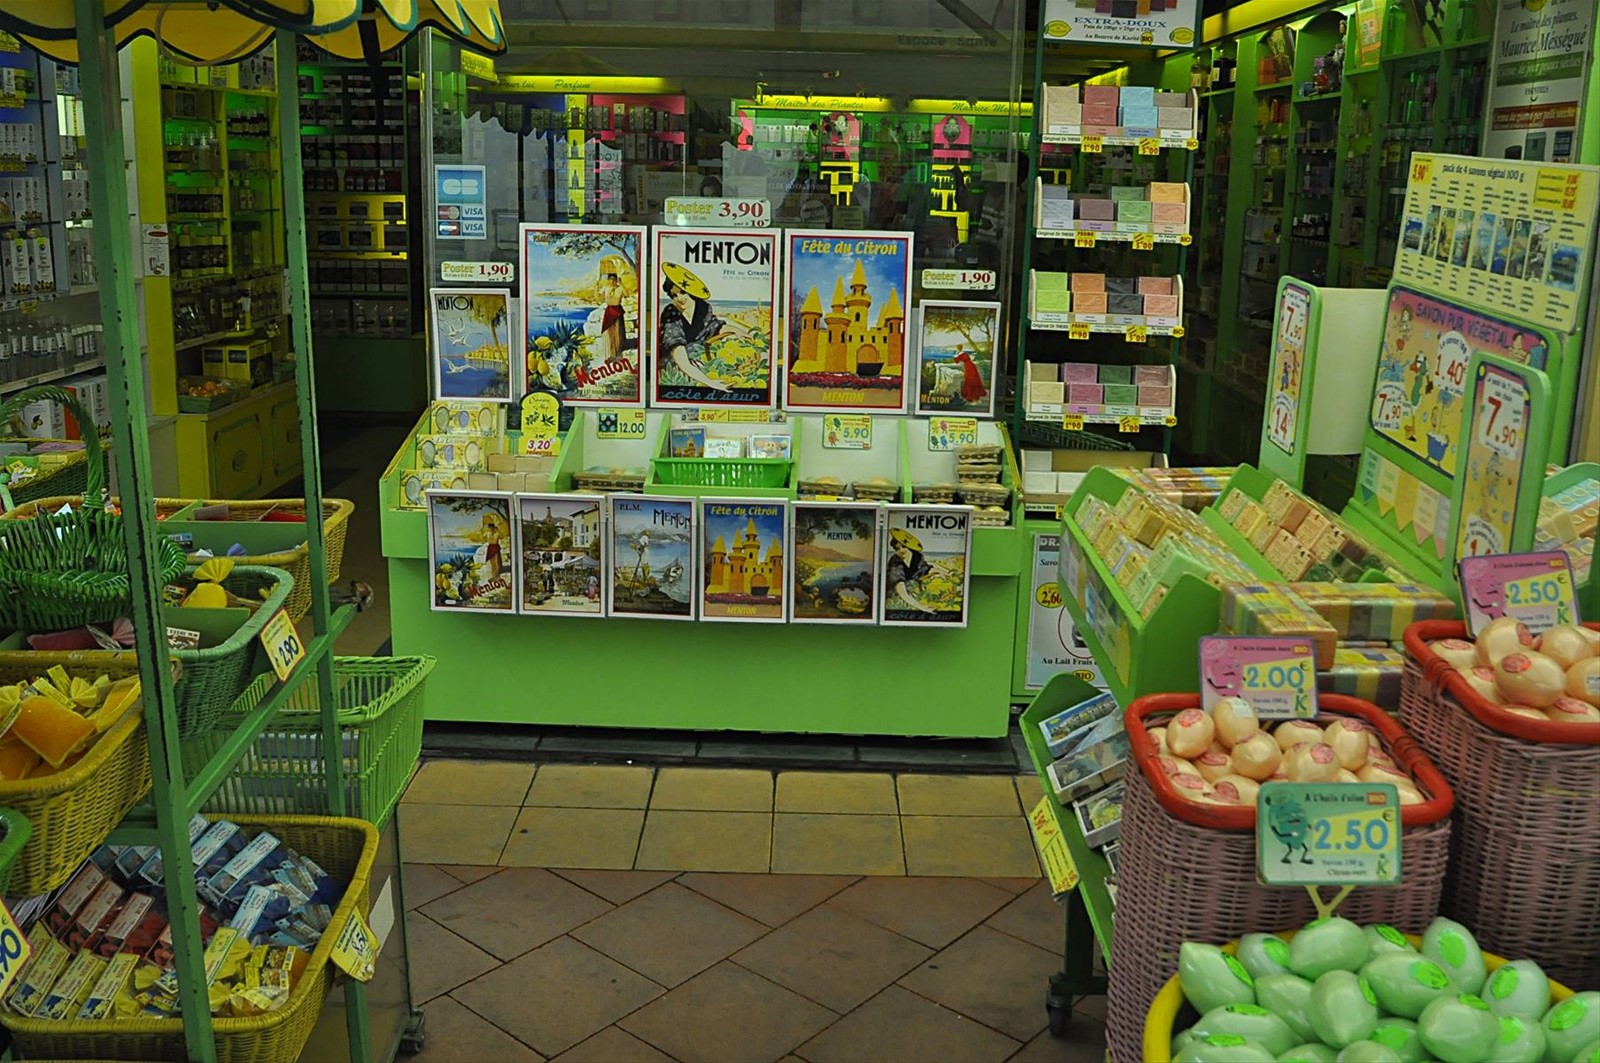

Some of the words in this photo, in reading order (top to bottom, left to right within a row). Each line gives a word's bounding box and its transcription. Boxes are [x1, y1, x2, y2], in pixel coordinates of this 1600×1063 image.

[1075, 17, 1167, 28] EXTRA-DOUX
[554, 79, 591, 90] Parfum
[464, 207, 483, 216] VISA
[667, 201, 712, 214] Poster
[719, 202, 764, 219] 3,90
[464, 223, 484, 231] VISA
[685, 241, 770, 265] MENTON
[802, 240, 829, 254] Fête
[834, 241, 851, 254] du
[855, 240, 897, 256] Citron
[443, 263, 475, 274] Poster
[478, 265, 508, 277] 1,90
[923, 272, 956, 282] Poster
[960, 273, 990, 285] 1,90
[574, 357, 636, 388] Menton
[662, 388, 701, 400] côte
[823, 392, 864, 402] MENTON
[921, 393, 950, 404] MENTON
[619, 422, 645, 434] 12.00
[843, 427, 869, 439] 5.90
[949, 433, 974, 444] 5.90
[711, 506, 731, 516] Fête
[733, 506, 745, 516] du
[748, 506, 778, 516] Citron
[653, 508, 691, 529] MENTON
[906, 515, 966, 530] MENTON
[826, 532, 853, 541] MENTON
[1039, 558, 1058, 566] Savo
[467, 578, 510, 600] Menton
[1509, 580, 1559, 604] 2.50
[727, 606, 757, 615] MENTON
[1055, 657, 1071, 665] Lait
[1073, 657, 1093, 666] Frais
[1075, 672, 1091, 680] BIO
[1247, 666, 1304, 689] 2.00
[1314, 819, 1389, 850] 2.50
